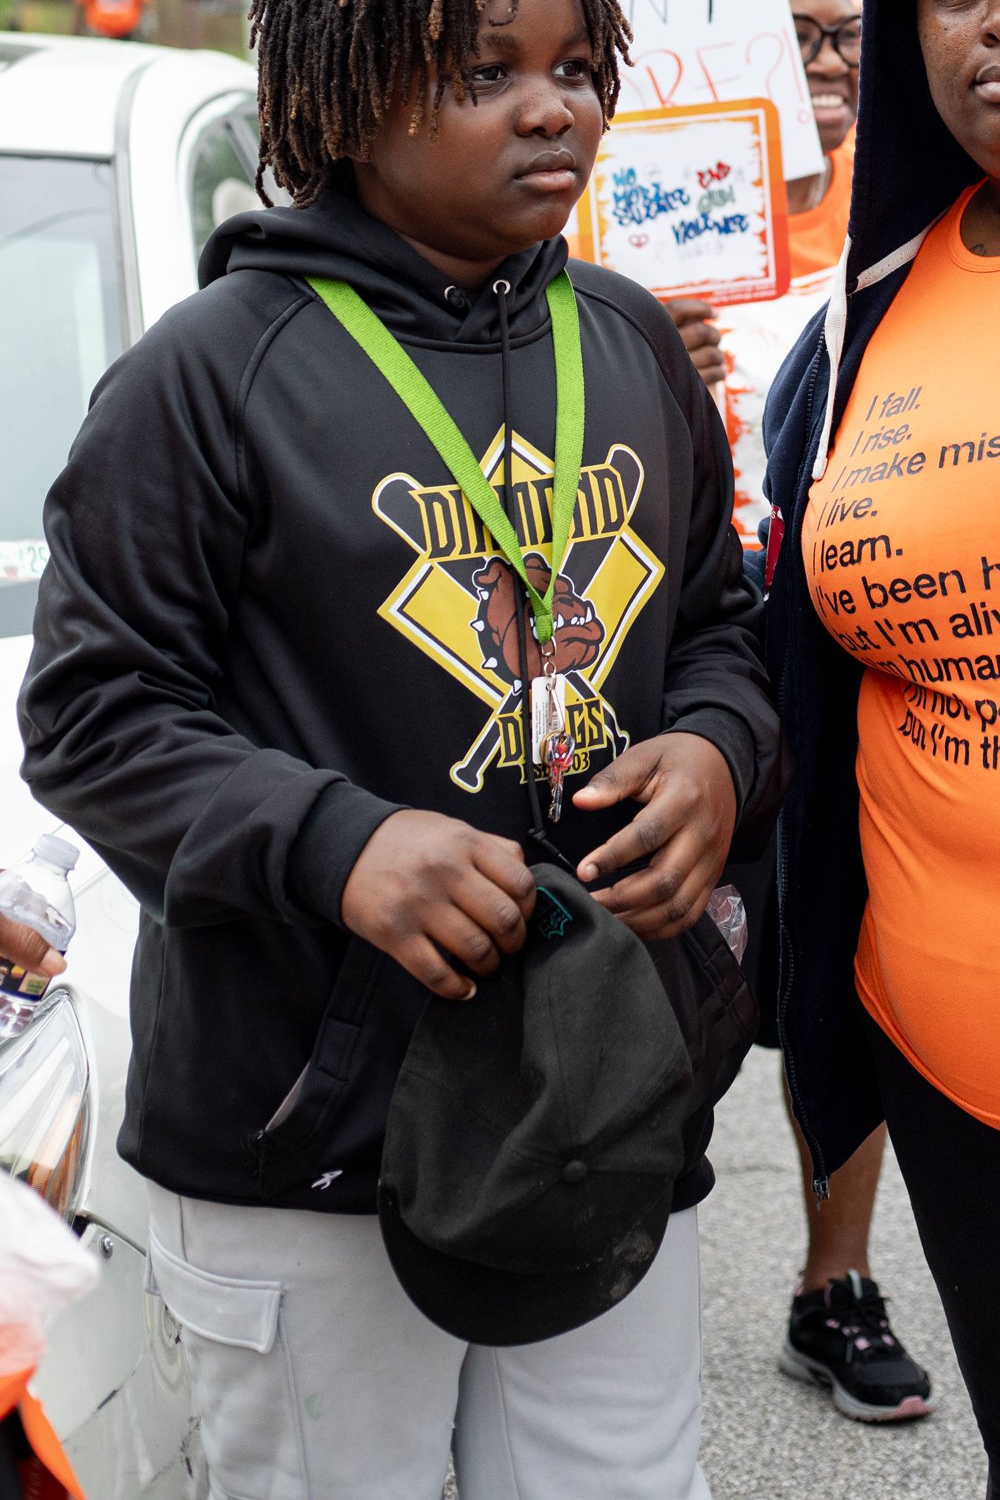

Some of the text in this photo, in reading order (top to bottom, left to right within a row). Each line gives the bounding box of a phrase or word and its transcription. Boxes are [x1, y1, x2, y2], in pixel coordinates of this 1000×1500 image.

[865, 386, 922, 421] I fall.
[850, 423, 912, 457] I rise.
[831, 467, 847, 492] I
[842, 452, 926, 489] make
[825, 497, 878, 528] live.
[820, 534, 903, 572] learn.
[815, 585, 857, 618] I've
[861, 568, 967, 609] been
[874, 618, 940, 647] I'm
[498, 699, 605, 764] DGS
[930, 723, 970, 766] I'm
